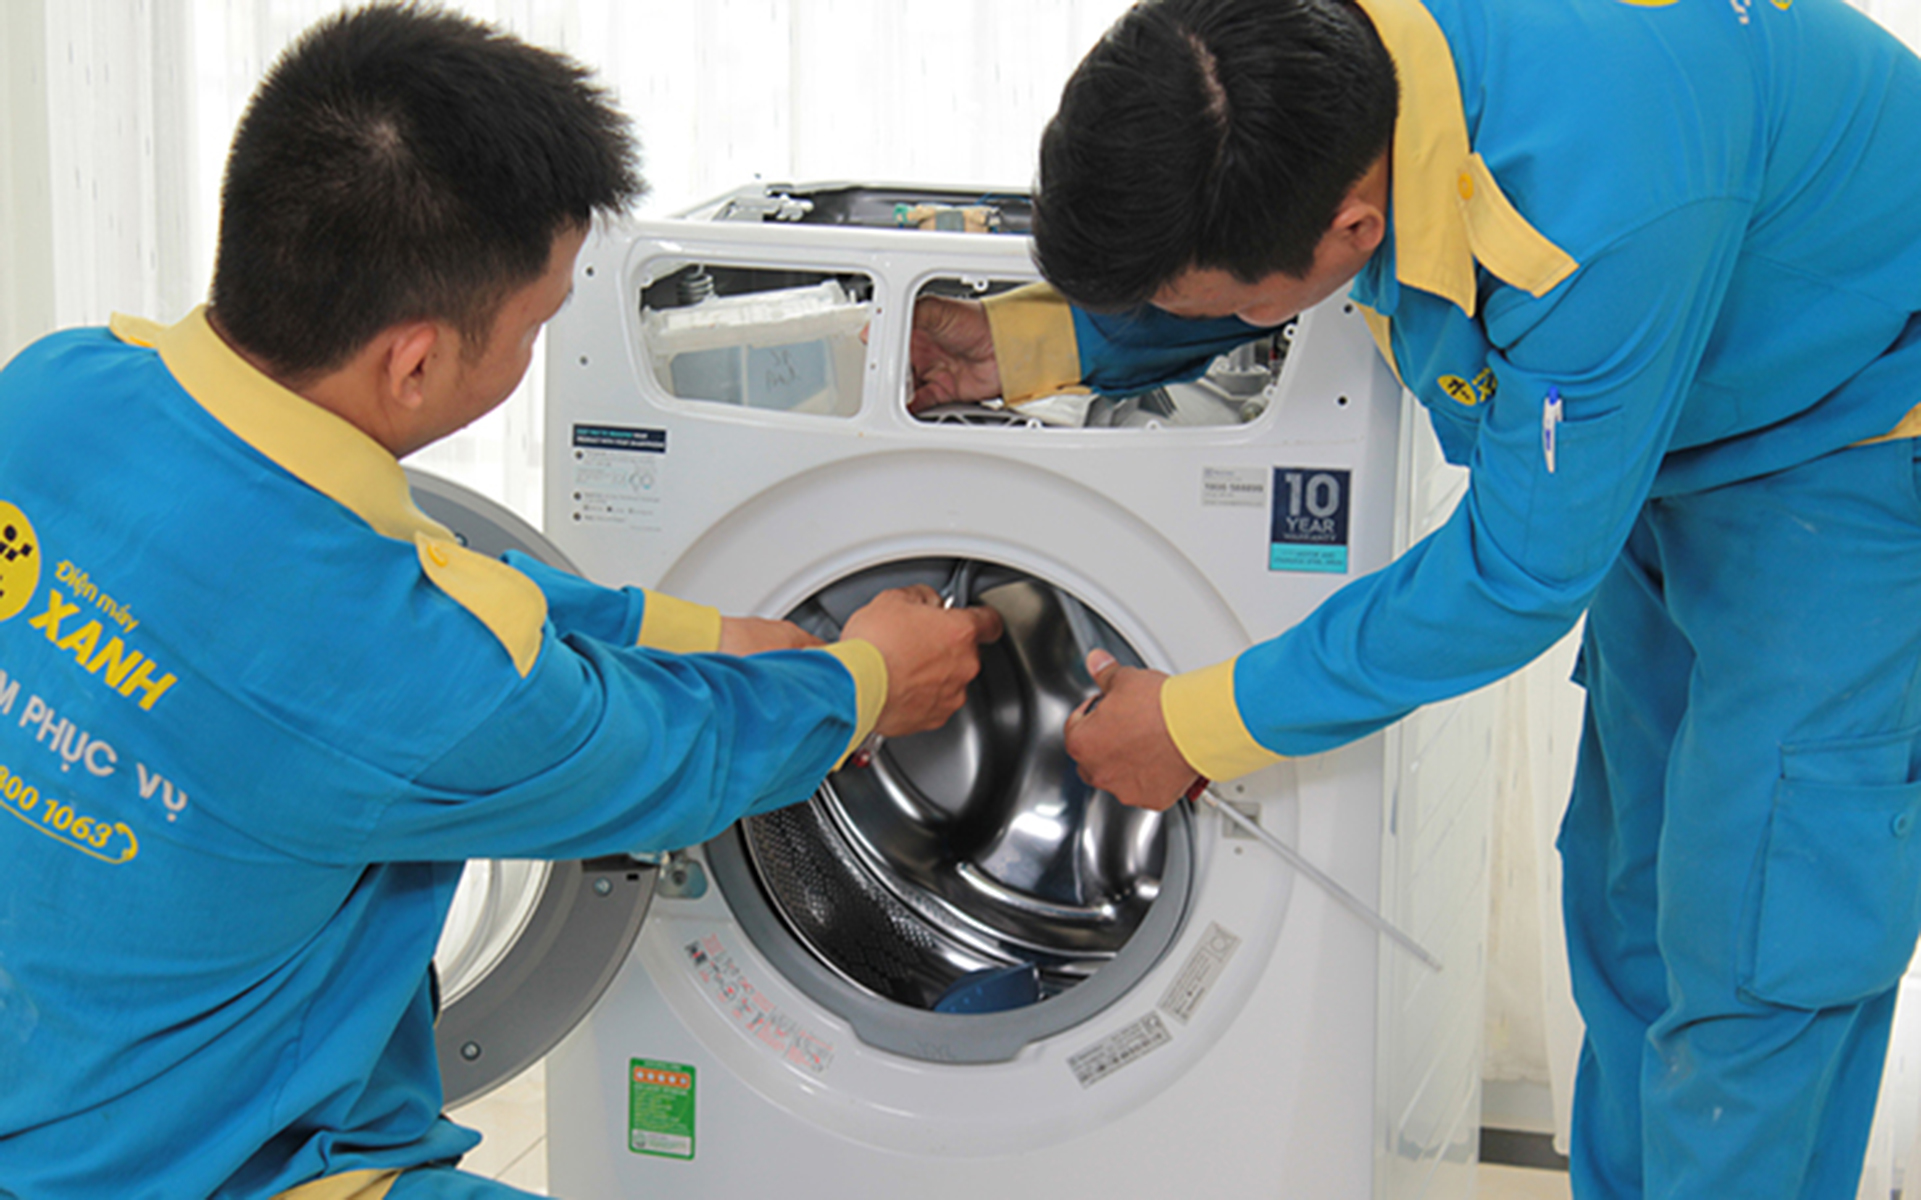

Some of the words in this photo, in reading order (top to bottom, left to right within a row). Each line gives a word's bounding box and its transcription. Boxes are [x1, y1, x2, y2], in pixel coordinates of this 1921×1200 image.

[1284, 473, 1340, 518] 10
[1285, 516, 1335, 534] YEAR
[55, 559, 98, 602] Điện
[96, 593, 140, 634] máy
[28, 588, 178, 711] XANH
[18, 694, 118, 777] PHỤC
[136, 762, 189, 822] VỤ
[43, 799, 113, 848] 1063
